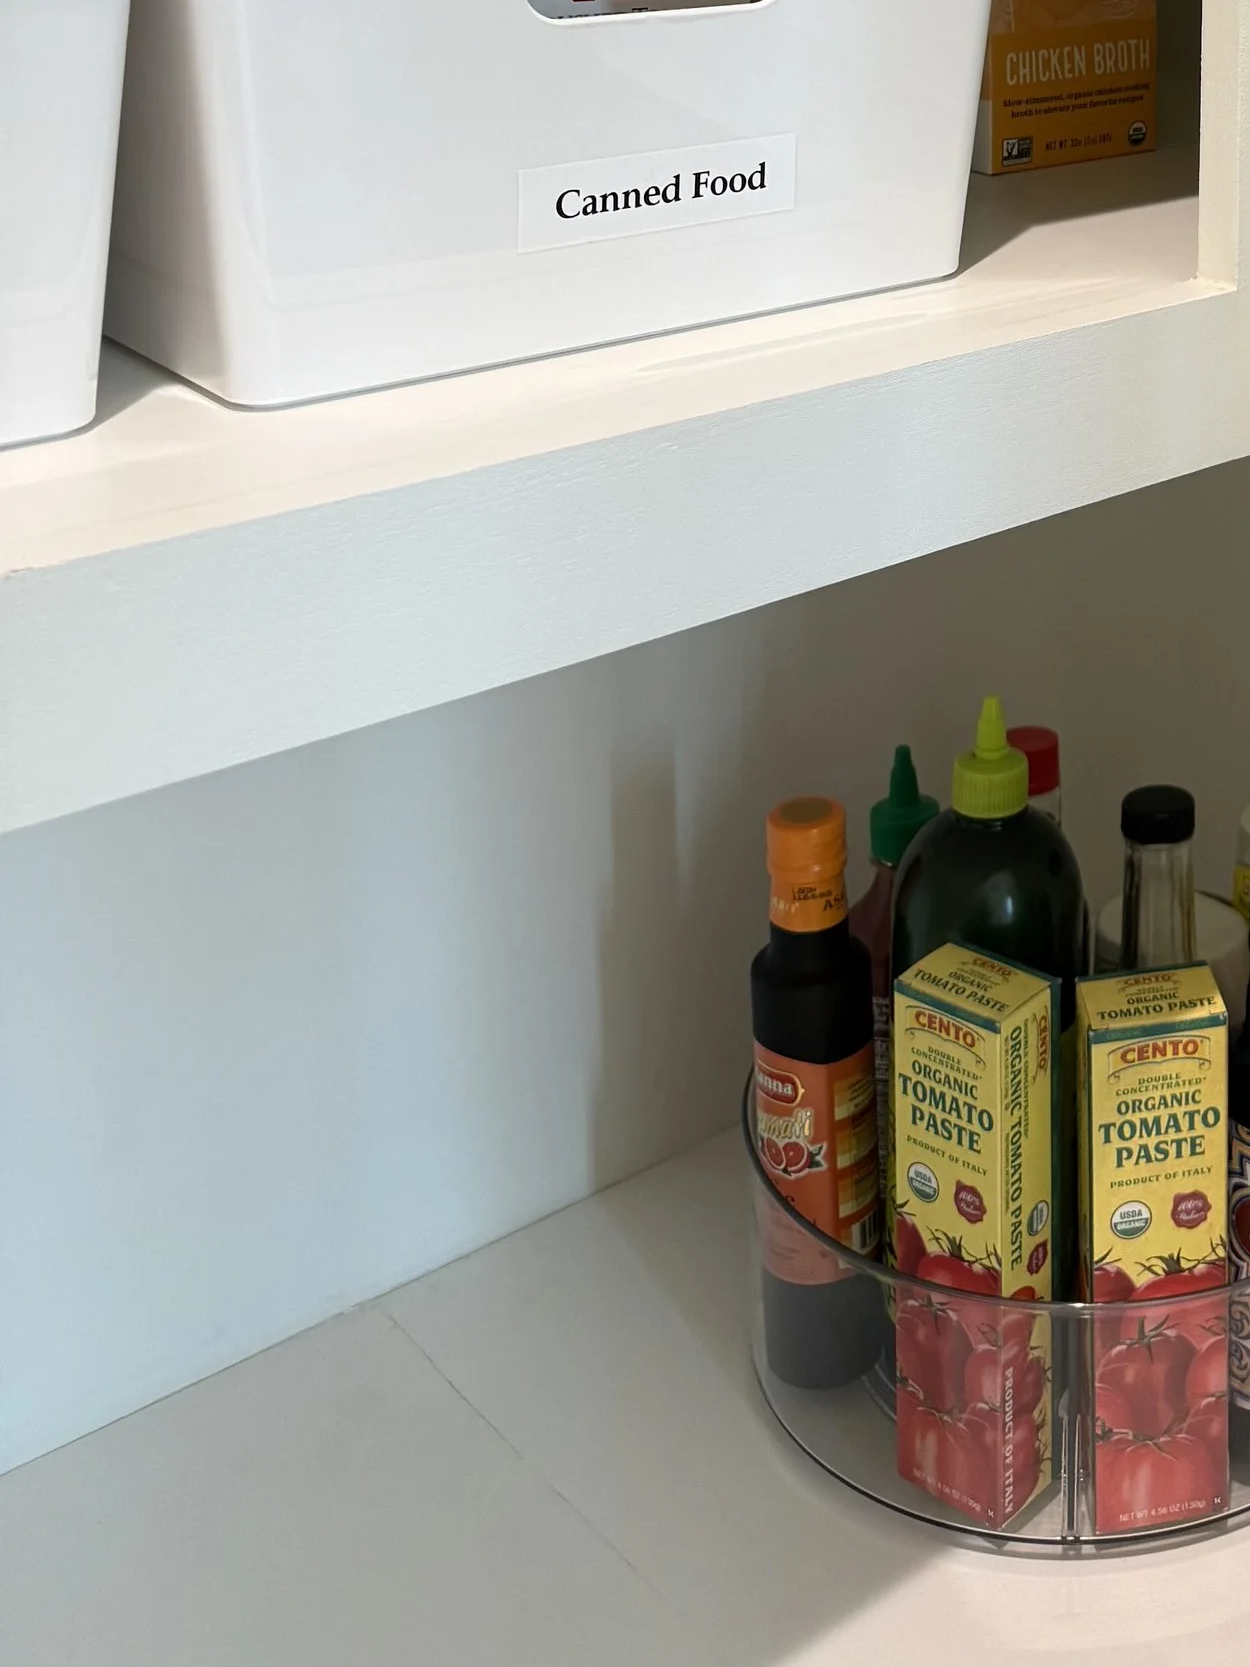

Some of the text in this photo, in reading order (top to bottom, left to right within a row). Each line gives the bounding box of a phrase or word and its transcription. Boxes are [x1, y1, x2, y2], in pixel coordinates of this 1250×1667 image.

[1006, 37, 1150, 85] CHICKEN BROTH
[555, 161, 768, 219] Canned Food
[914, 969, 966, 995] TOMATO
[966, 990, 1008, 1012] PASTE
[949, 971, 992, 992] ORGANIC
[1127, 991, 1180, 1005] ORGANIC
[1097, 996, 1216, 1020] TOMATO PASTE
[915, 1010, 976, 1048] CENTO
[1039, 1015, 1049, 1070] CENTO
[928, 1046, 961, 1066] DOUBLE
[1120, 1039, 1199, 1064] CENTO
[912, 1060, 978, 1100] ORGANIC
[1138, 1072, 1182, 1085] DOUBLE
[899, 1072, 994, 1132] TOMATO
[1117, 1089, 1202, 1116] ORGANIC
[911, 1104, 982, 1154] PASTE
[1098, 1106, 1221, 1144] TOMATO
[907, 1135, 987, 1176] PRODUCT OF ITALY
[1010, 1026, 1023, 1270] ORGANIC TOMATO PASTE
[1116, 1135, 1205, 1168] PASTE
[914, 1169, 932, 1183] USDA
[1110, 1166, 1213, 1189] PRODUCT OF ITALY
[1120, 1209, 1143, 1220] USDA
[1005, 1367, 1014, 1513] PRODUCT OF ITALY
[1120, 1499, 1206, 1522] NET WT 4.56 OZ (130g)
